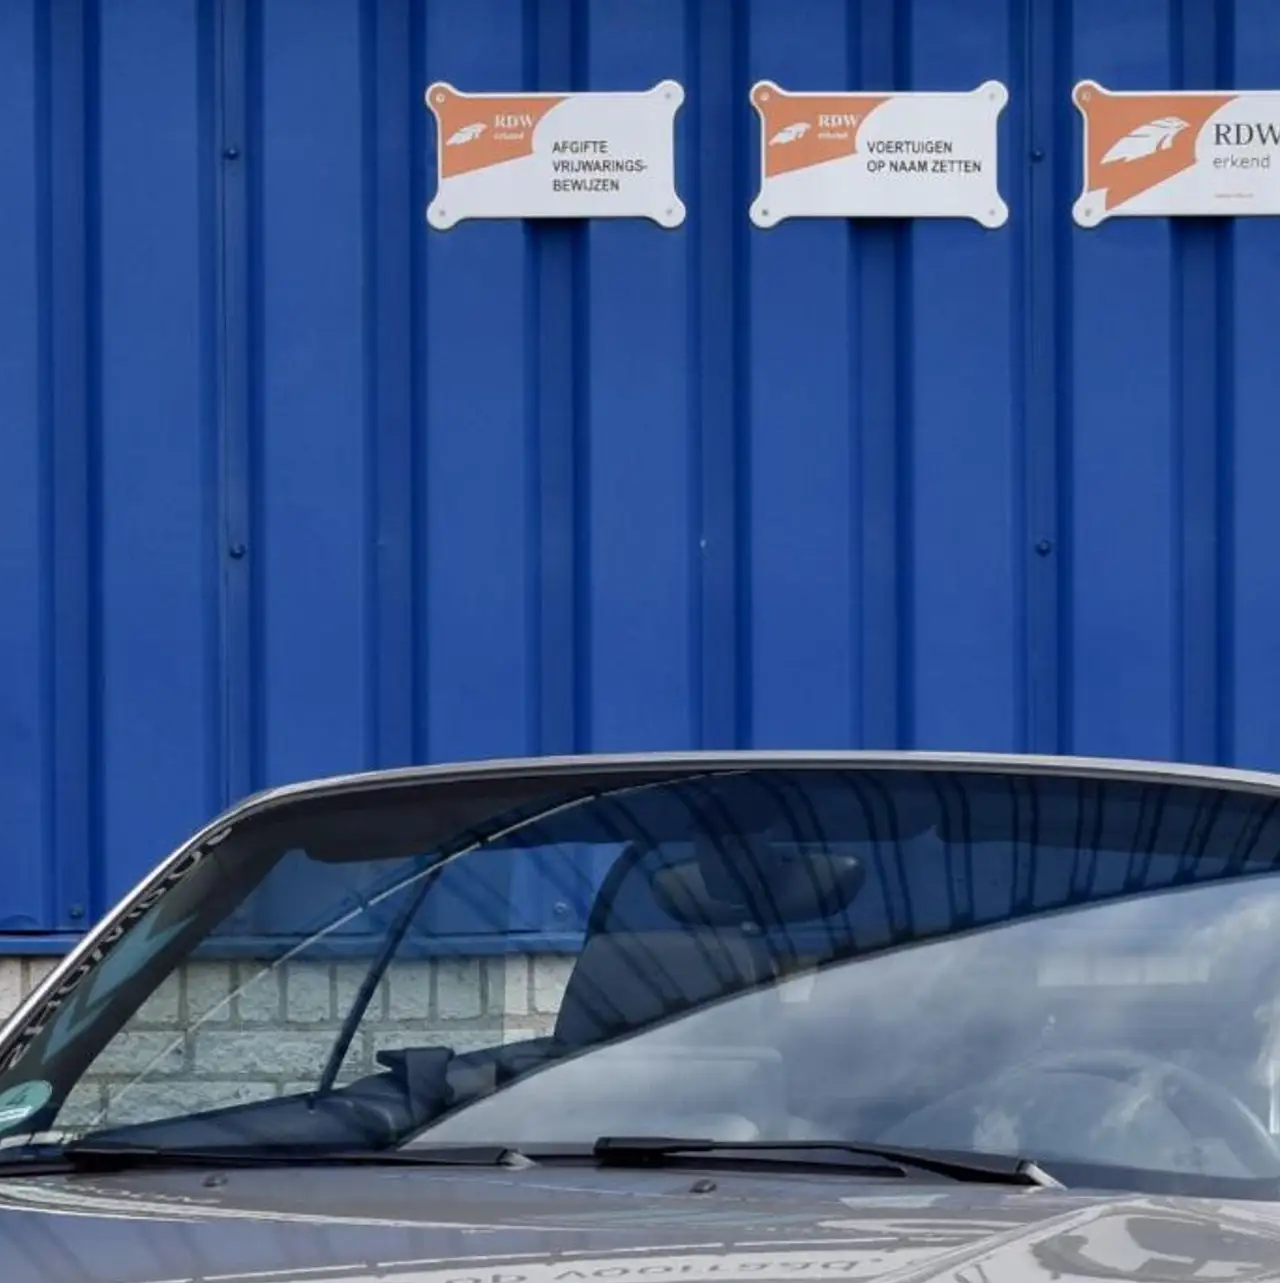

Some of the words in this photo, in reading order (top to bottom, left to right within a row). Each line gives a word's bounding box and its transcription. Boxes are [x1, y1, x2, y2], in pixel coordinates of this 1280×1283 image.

[494, 114, 534, 128] RDW
[818, 114, 858, 128] RDW
[552, 140, 609, 153] AFGIFTE
[866, 140, 953, 153] VOERTUIGEN
[552, 159, 648, 172] VRIJWARINGS-
[866, 160, 886, 172] OP
[889, 160, 928, 172] NAAM
[931, 160, 981, 172] ZETTEN
[1213, 154, 1270, 169] erkend
[552, 179, 620, 191] BEWIJZEN
